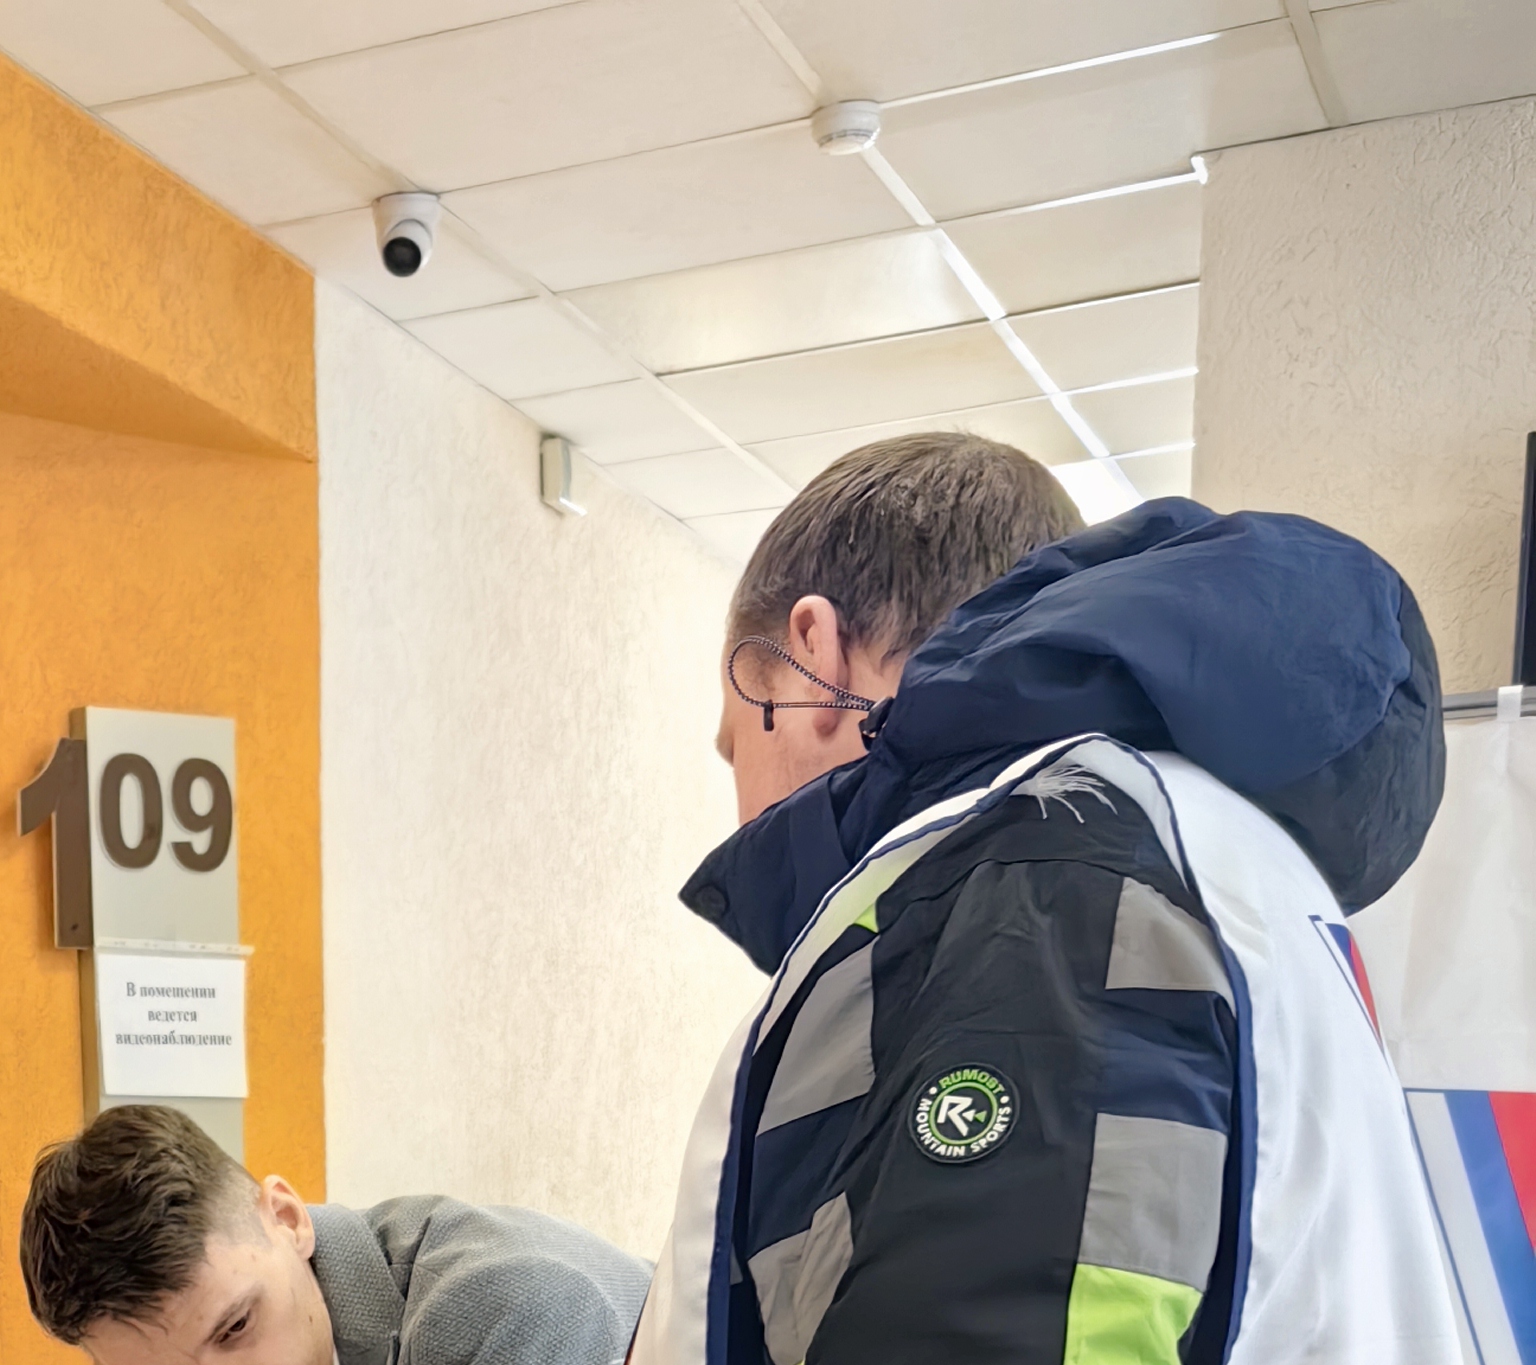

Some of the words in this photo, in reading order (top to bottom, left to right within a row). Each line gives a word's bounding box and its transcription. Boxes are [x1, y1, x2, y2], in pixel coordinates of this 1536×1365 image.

[18, 737, 234, 950] 109
[126, 981, 137, 998] В
[915, 1098, 966, 1157] MOUNTAIN
[970, 1106, 1012, 1153] SPORTS
